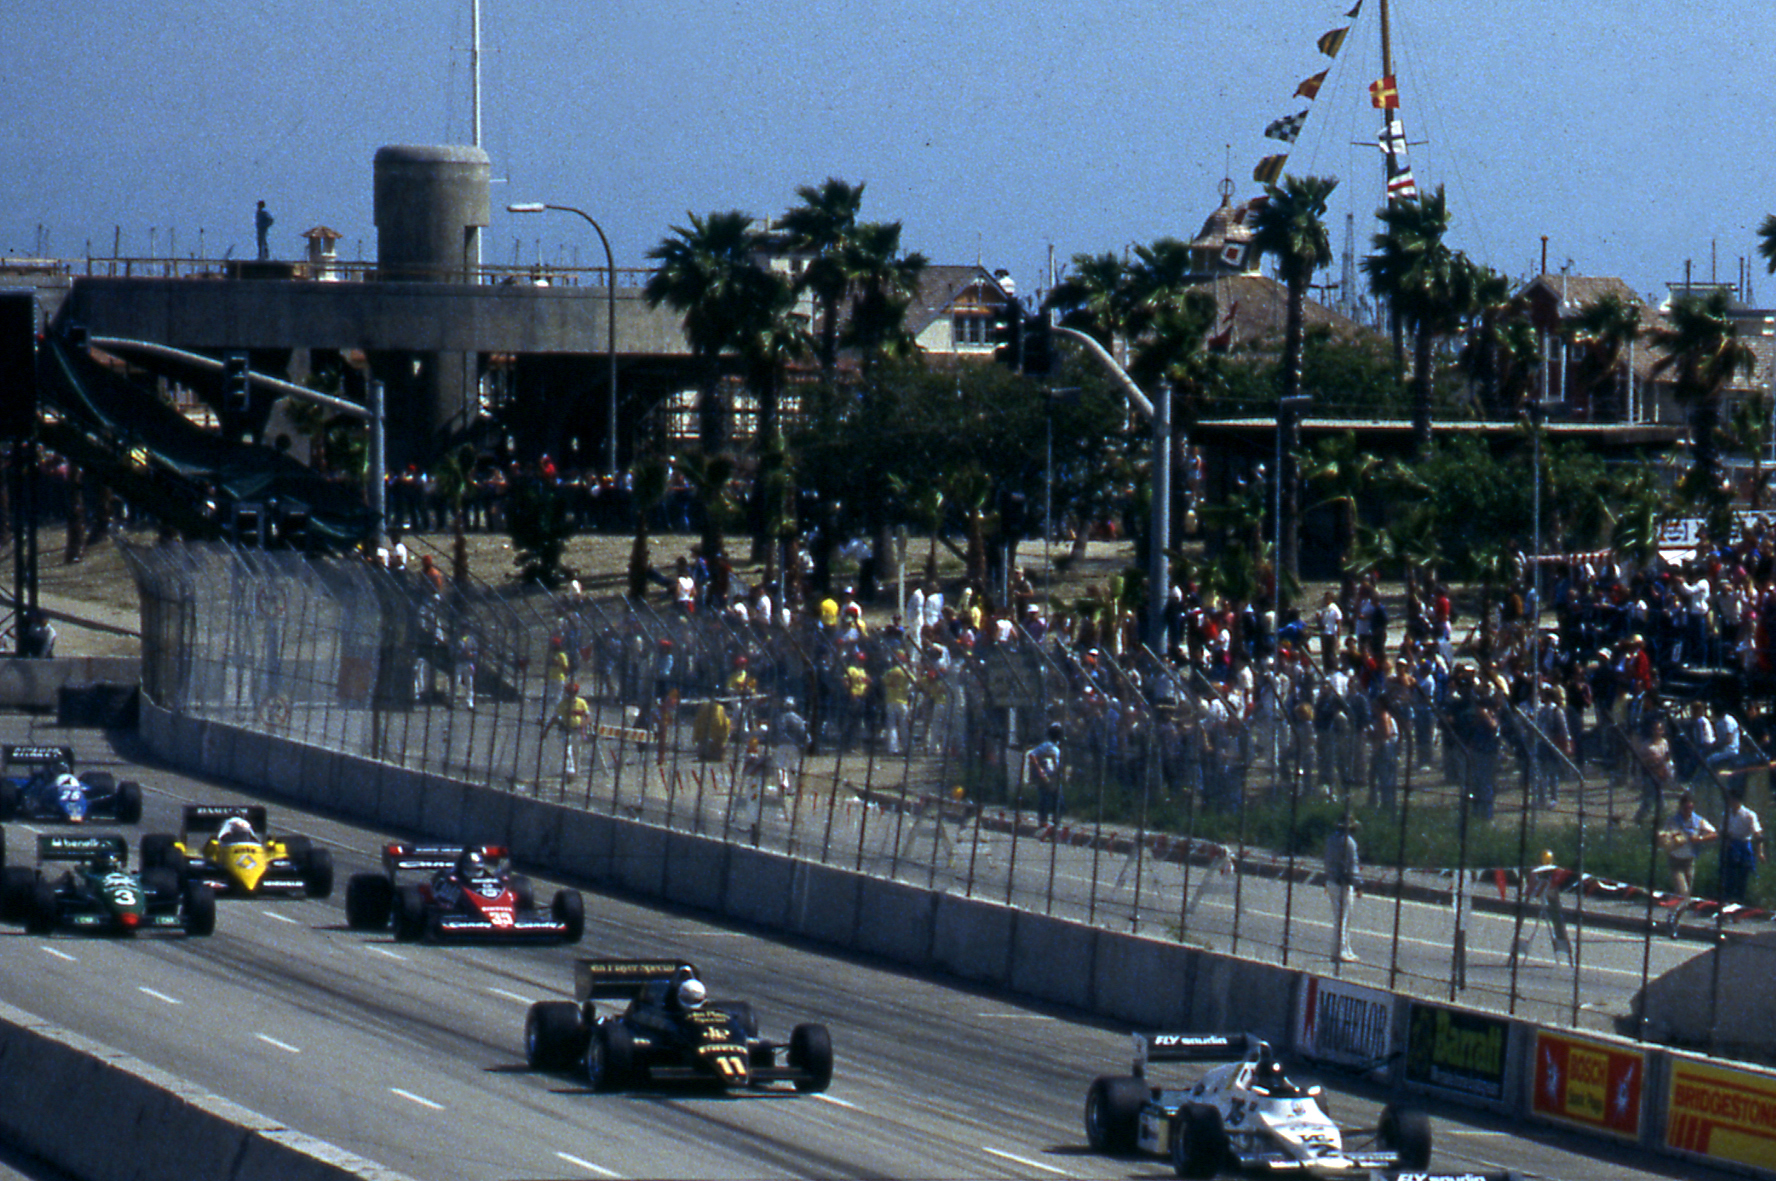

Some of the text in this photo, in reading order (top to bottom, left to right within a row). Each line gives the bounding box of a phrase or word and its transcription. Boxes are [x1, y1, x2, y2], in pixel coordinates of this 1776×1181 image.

[114, 889, 136, 906] 3
[1155, 1036, 1180, 1046] FLY
[717, 1056, 747, 1076] 11
